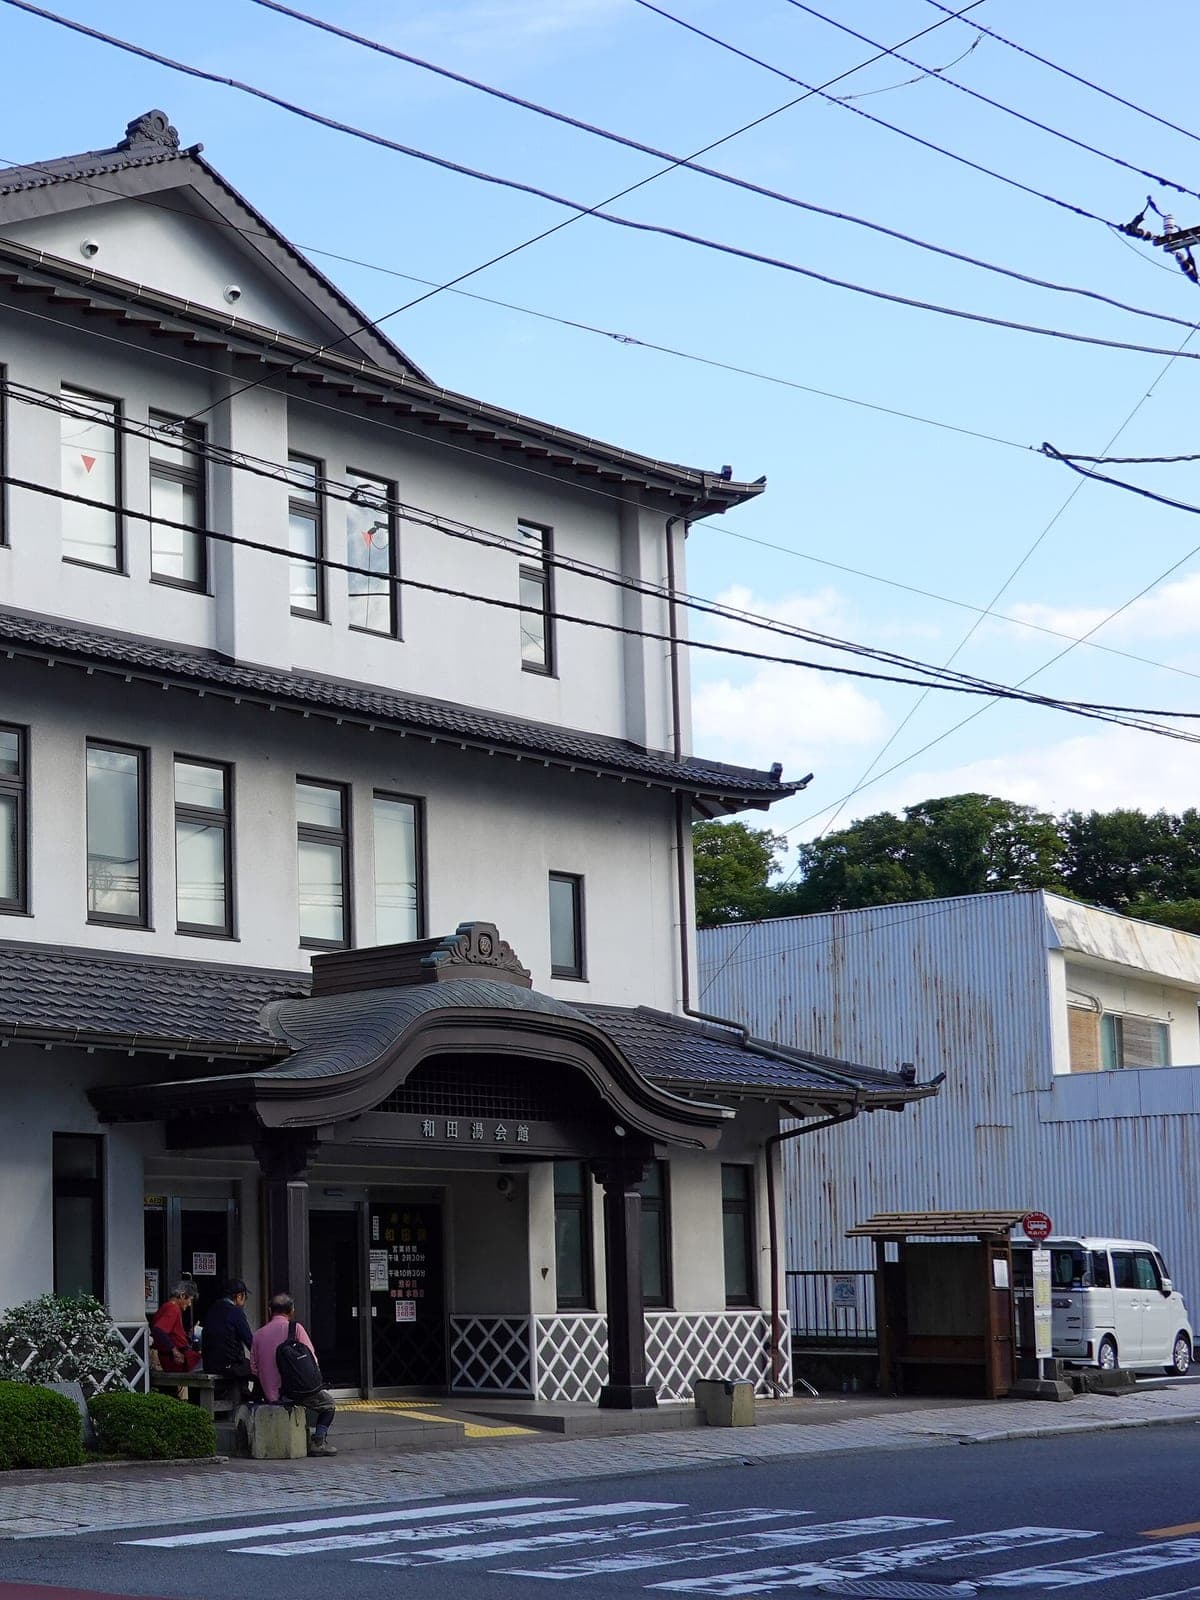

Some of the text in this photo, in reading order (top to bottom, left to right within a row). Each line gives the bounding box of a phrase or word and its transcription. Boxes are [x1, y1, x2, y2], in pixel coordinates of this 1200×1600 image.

[421, 1118, 529, 1143] 和田湯会館
